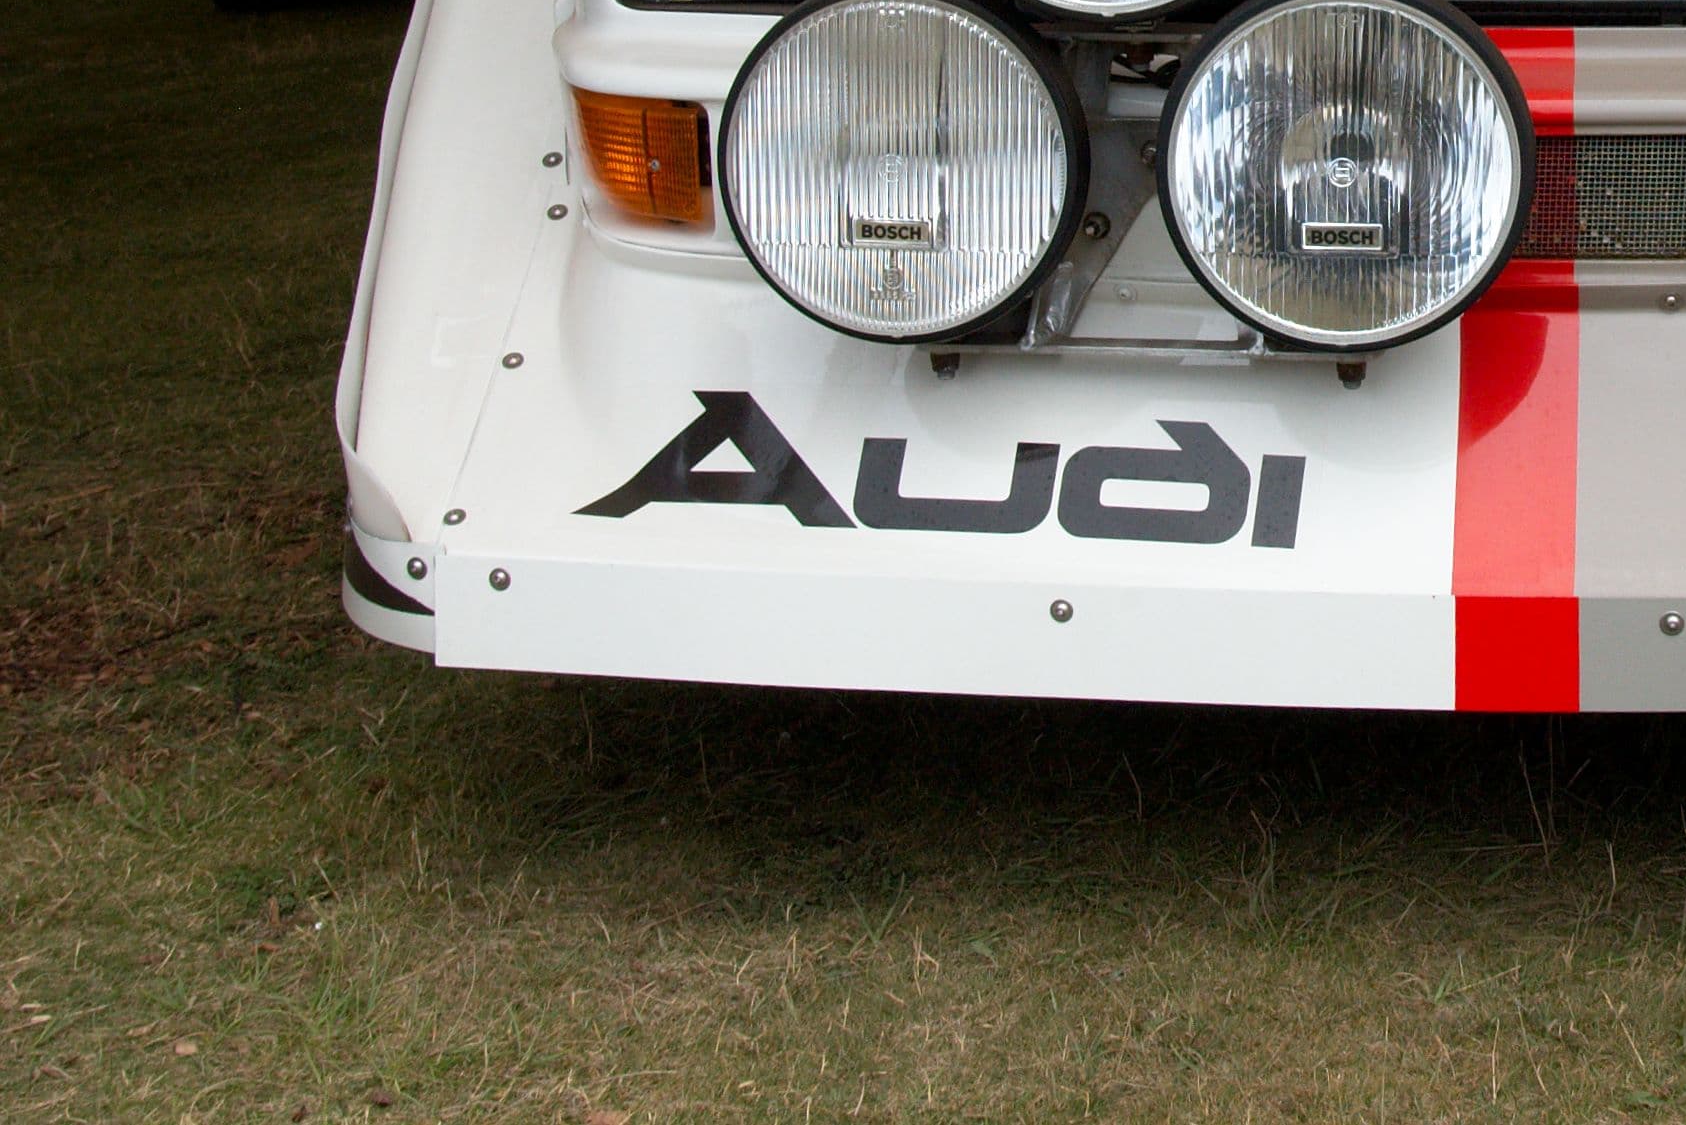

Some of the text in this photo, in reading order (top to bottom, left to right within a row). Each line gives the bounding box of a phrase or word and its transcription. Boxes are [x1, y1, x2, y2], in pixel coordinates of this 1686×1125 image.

[861, 224, 922, 241] BOSCH
[1310, 229, 1374, 245] BOSCH
[571, 390, 1307, 550] Audi
